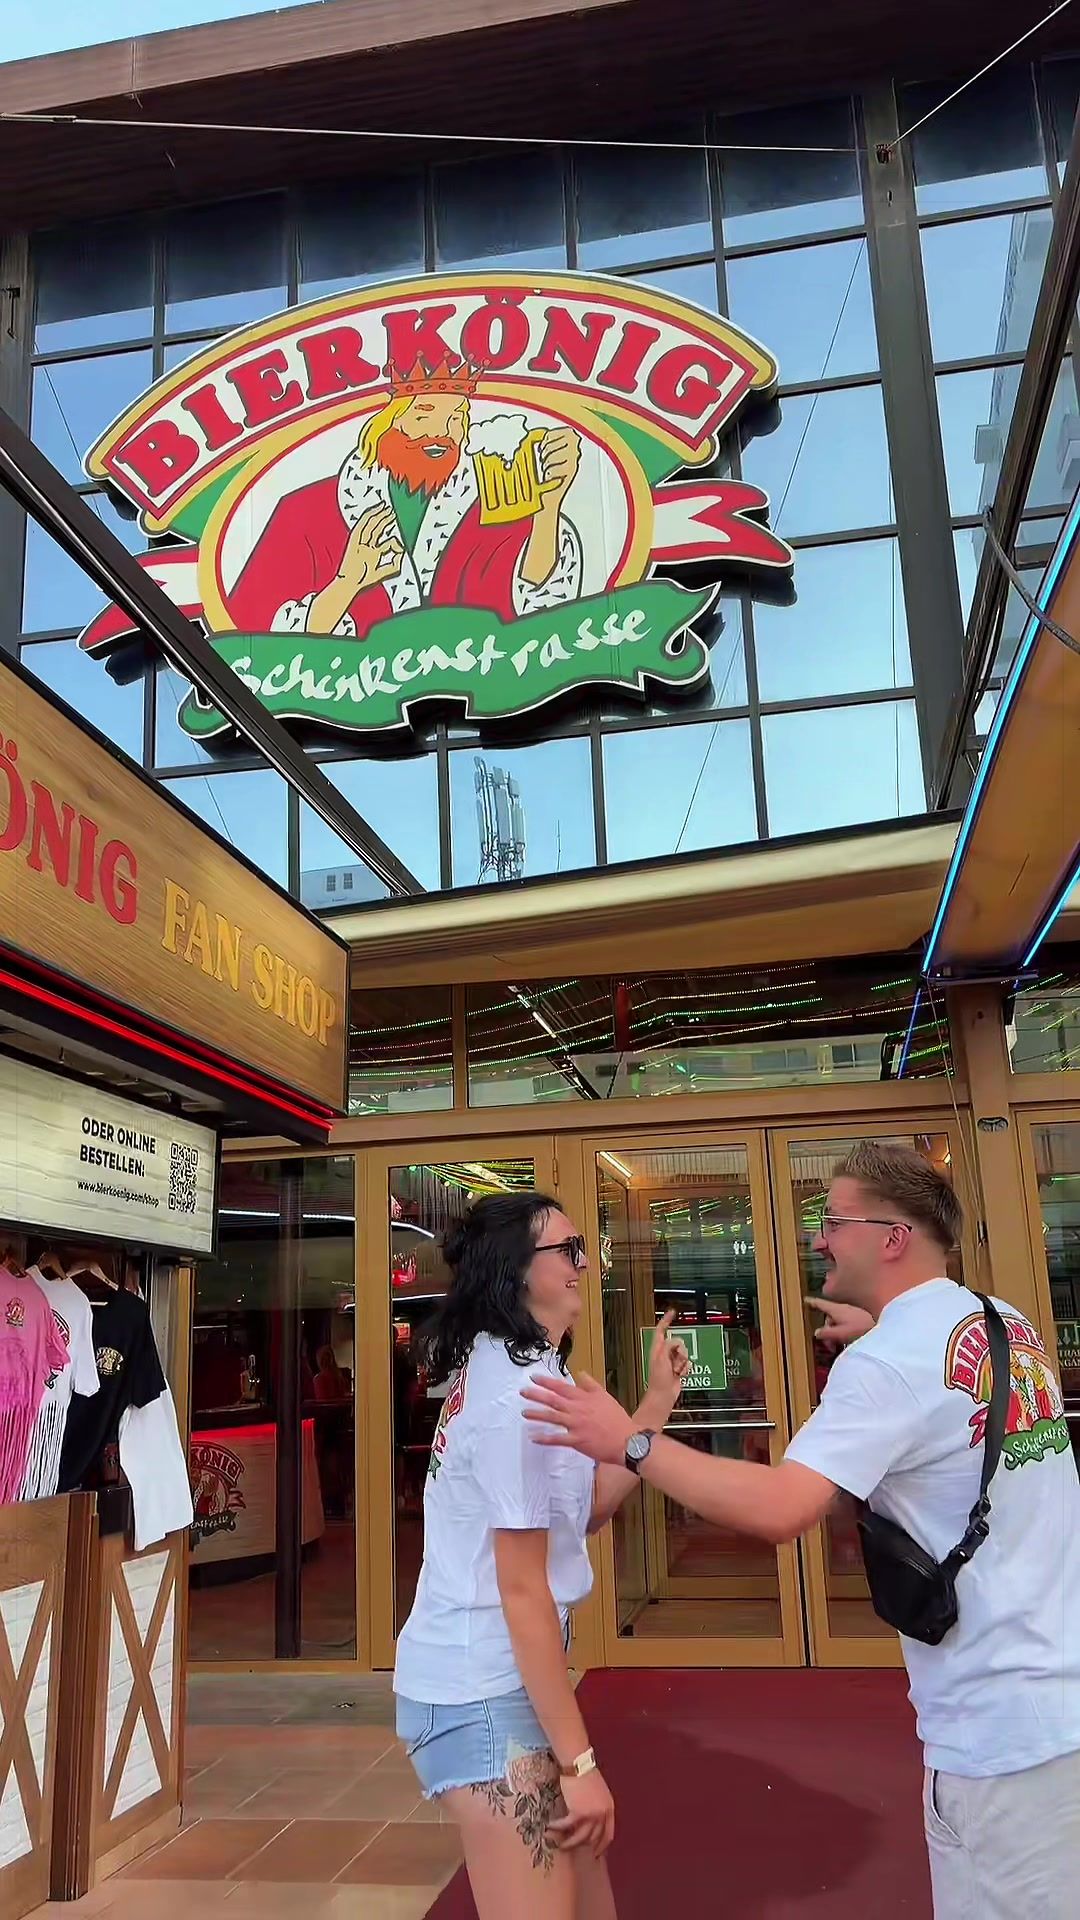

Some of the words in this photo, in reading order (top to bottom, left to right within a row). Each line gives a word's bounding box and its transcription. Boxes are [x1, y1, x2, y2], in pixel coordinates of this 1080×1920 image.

[121, 290, 738, 497] BIERKÖNIG
[162, 876, 242, 992] FAN
[250, 943, 336, 1047] SHOP
[80, 1144, 145, 1177] BESTELLEN:
[82, 1117, 114, 1142] ODER
[117, 1128, 156, 1154] ONLINE
